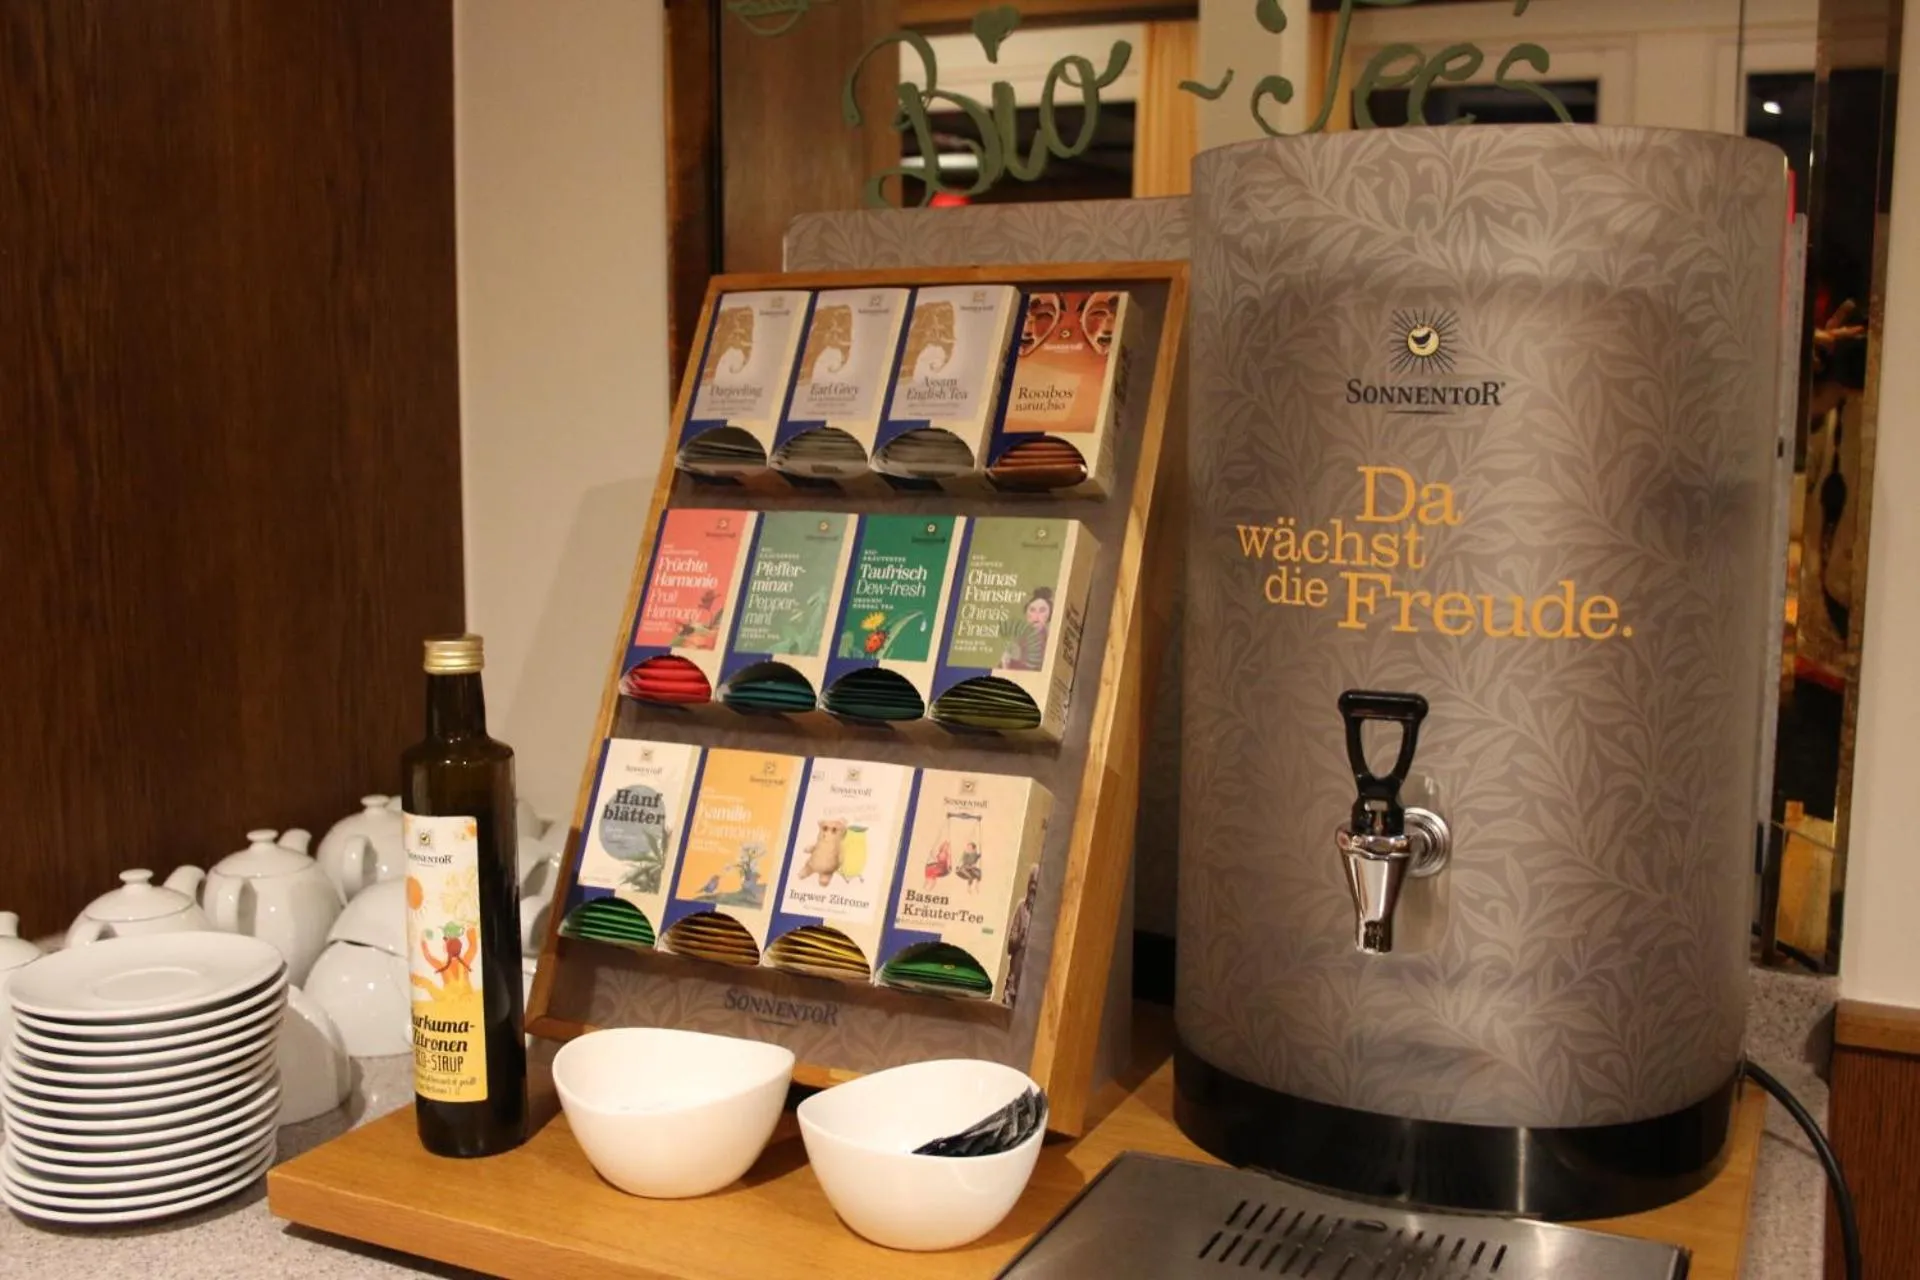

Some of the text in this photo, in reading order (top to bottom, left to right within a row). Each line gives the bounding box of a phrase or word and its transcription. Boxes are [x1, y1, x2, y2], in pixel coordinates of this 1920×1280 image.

[844, 4, 1132, 207] Bio
[1018, 385, 1073, 400] Rooibos
[1355, 465, 1463, 527] Da
[1236, 517, 1427, 569] wächst
[658, 557, 709, 574] Früchte
[755, 560, 806, 577] Pfeffer-
[860, 563, 928, 581] Taufrisch
[654, 572, 719, 589] Harmonie
[752, 577, 794, 592] minze
[968, 568, 1018, 587] Chinas
[856, 579, 926, 598] Dew-fresh
[965, 586, 1027, 603] Feinster
[1264, 566, 1634, 640] die Freude.
[744, 611, 774, 626] mint
[961, 604, 1010, 621] China's
[958, 620, 1000, 637] Finest
[614, 789, 663, 808] Hanf
[603, 804, 666, 825] blätter
[788, 889, 827, 905] Ingwer
[828, 894, 870, 909] Zitrone
[905, 889, 949, 905] Basen
[724, 988, 839, 1026] SONNENTOR
[413, 1015, 475, 1033] urkuma-
